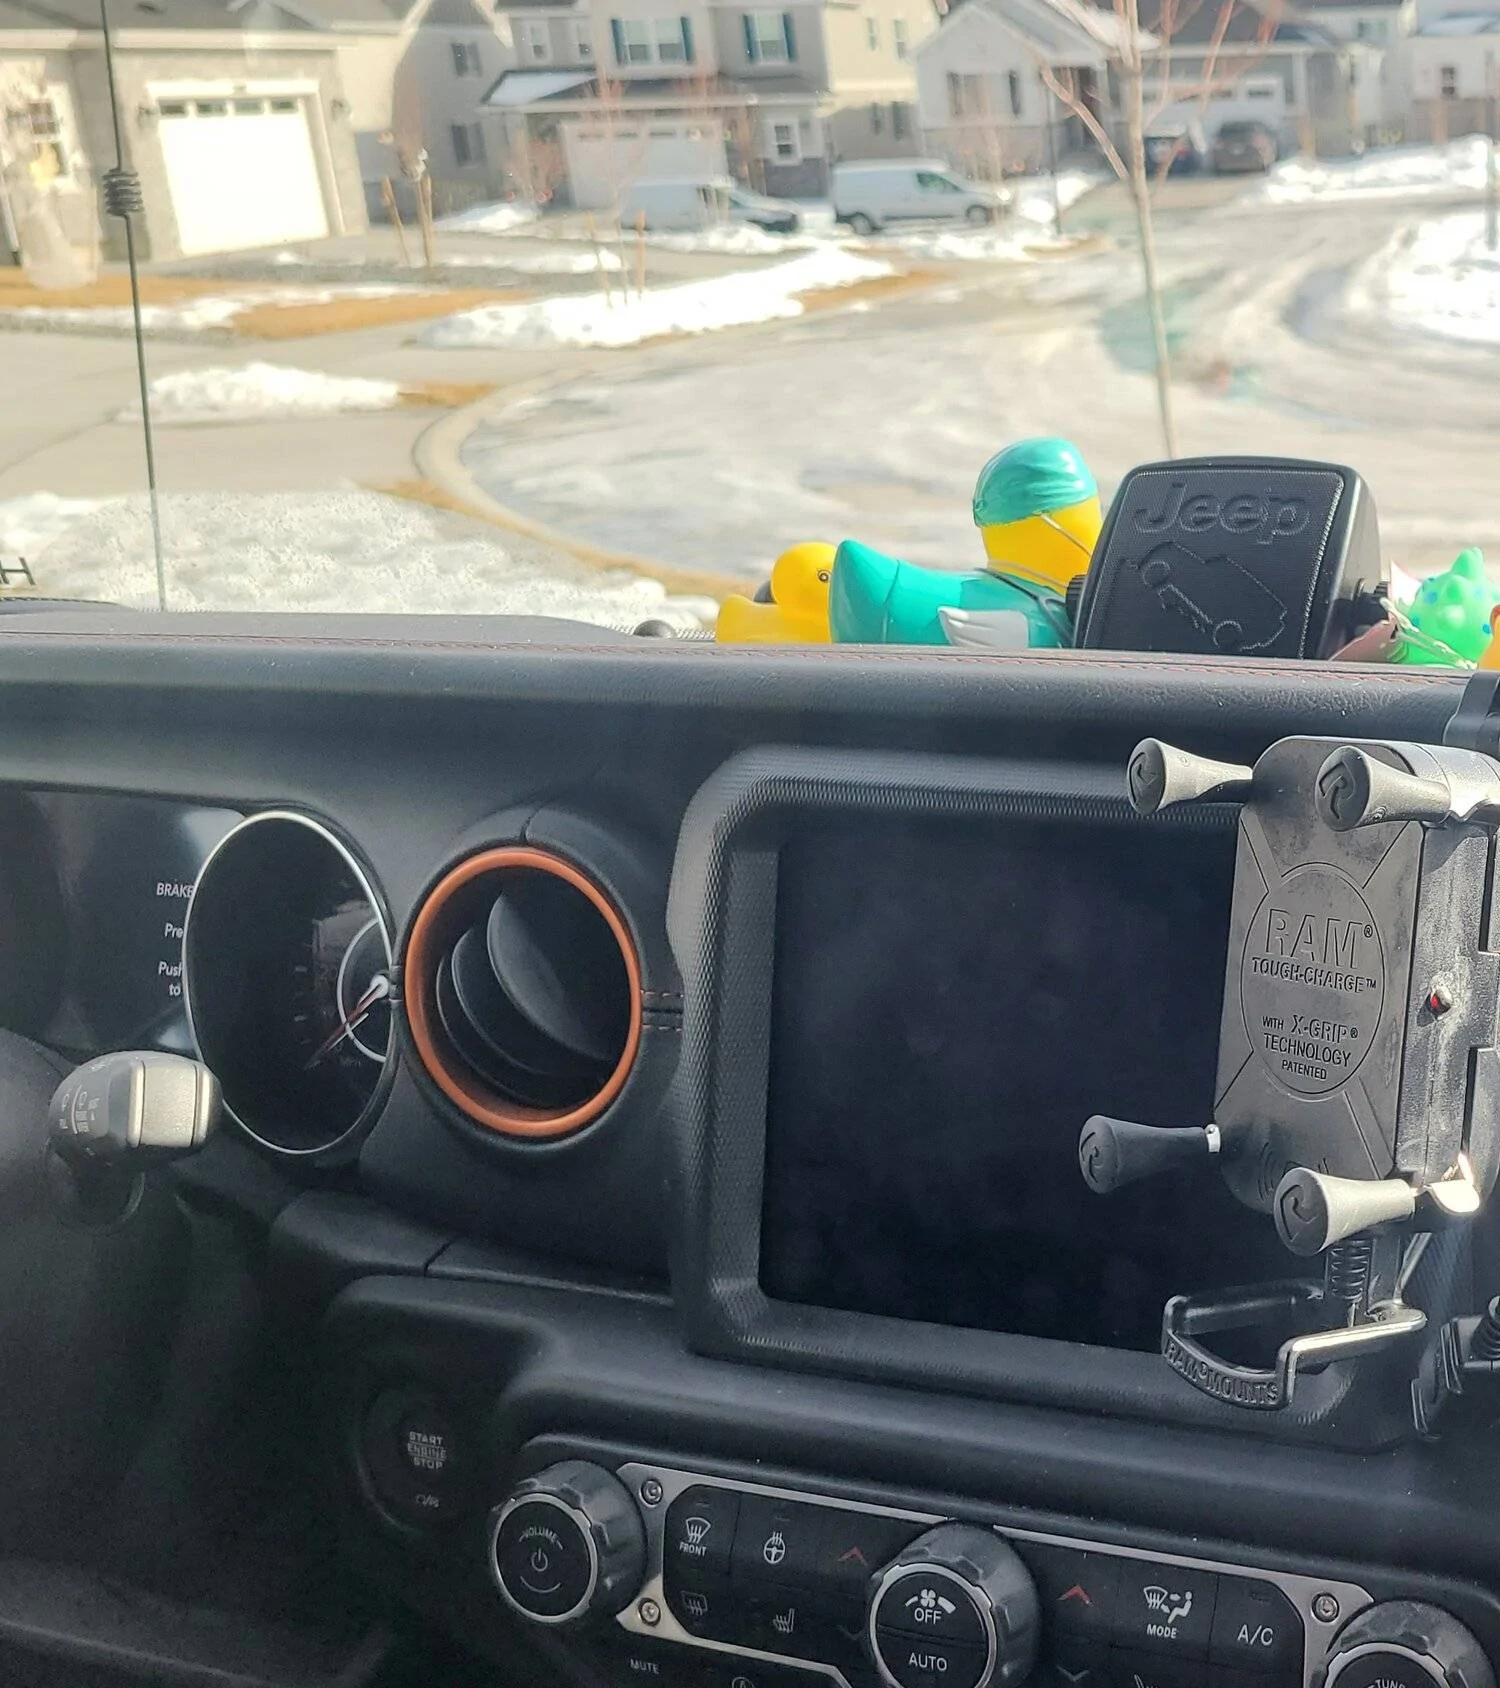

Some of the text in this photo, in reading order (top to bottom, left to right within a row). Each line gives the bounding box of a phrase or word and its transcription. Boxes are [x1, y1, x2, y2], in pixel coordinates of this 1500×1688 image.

[1132, 482, 1311, 545] Jeep
[168, 983, 181, 996] to
[1262, 1015, 1284, 1030] WITH
[1263, 1032, 1351, 1067] TECHNOLOGY
[1281, 1059, 1327, 1080] PATENTED
[409, 1431, 443, 1445] START
[413, 1456, 443, 1470] STOP
[679, 1541, 707, 1557] FRONT
[914, 1607, 942, 1625] OFF
[1146, 1623, 1177, 1639] MODE
[1237, 1623, 1274, 1646] A/C
[629, 1658, 660, 1675] MUTE
[909, 1652, 947, 1671] AUTO
